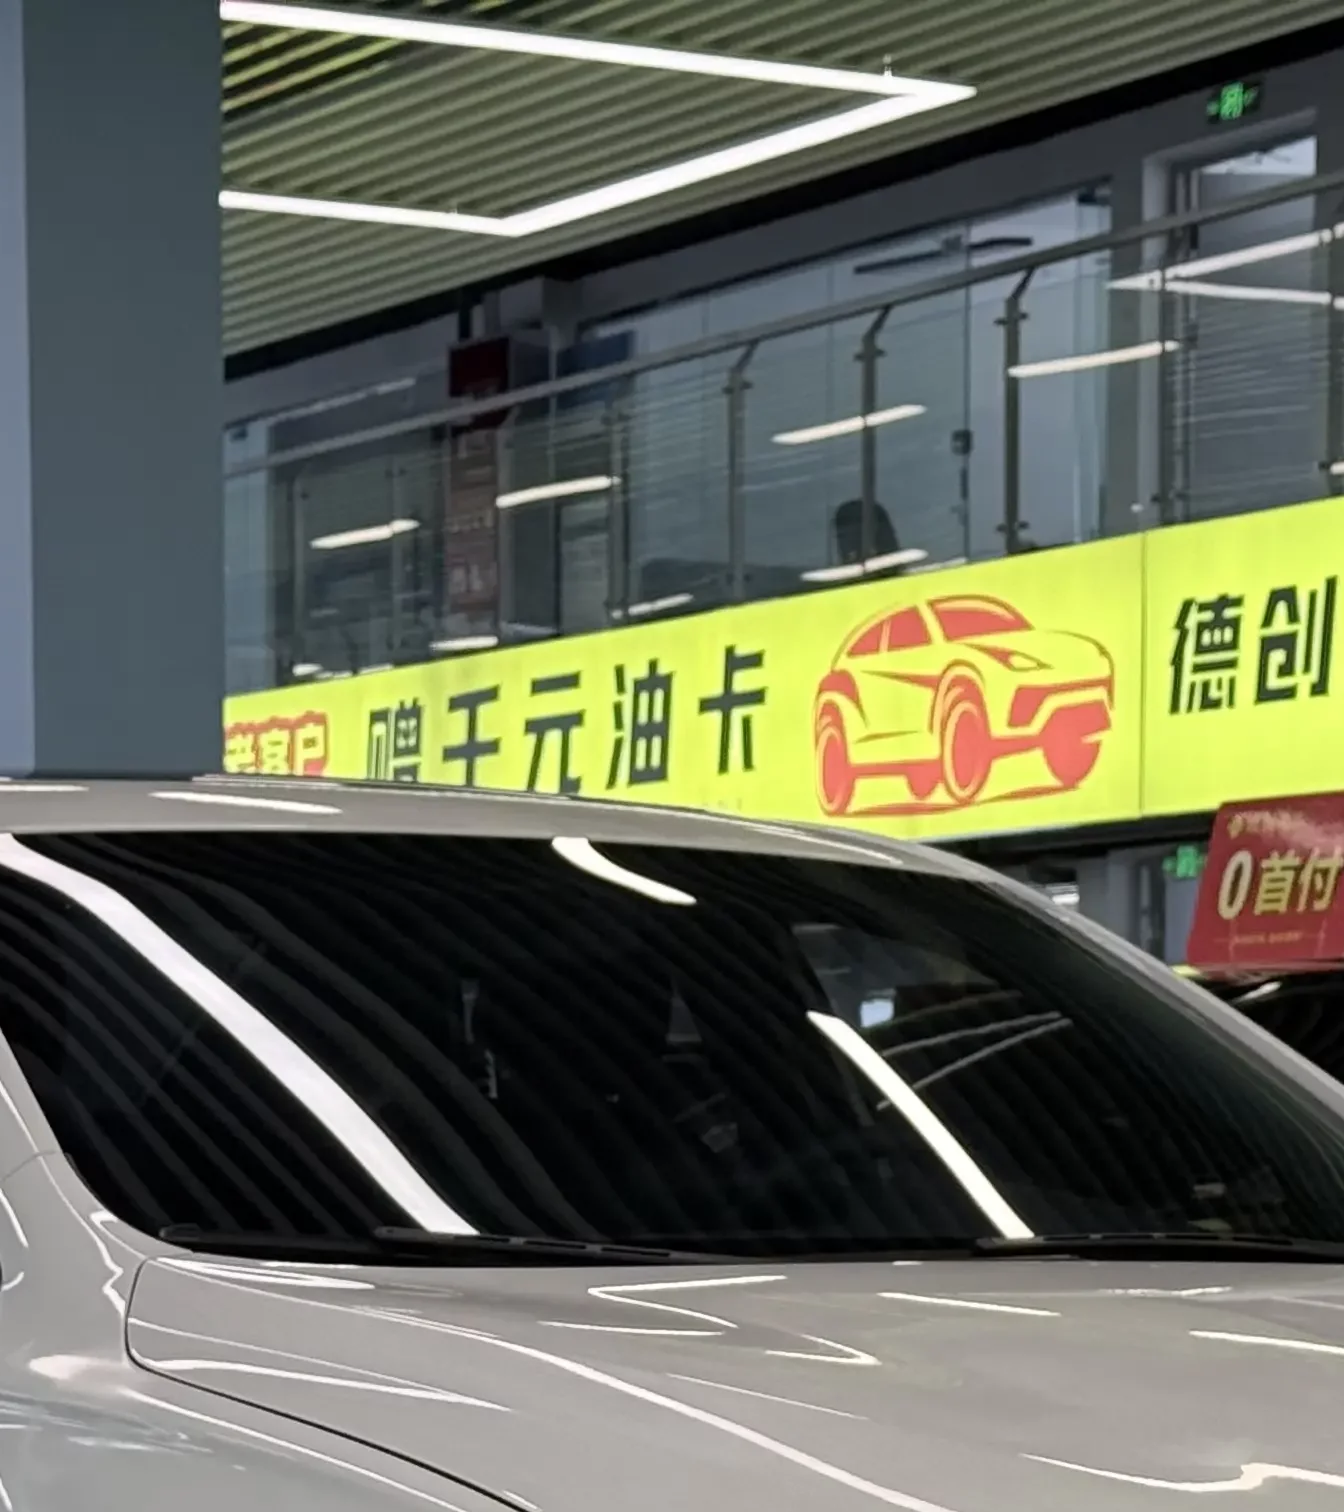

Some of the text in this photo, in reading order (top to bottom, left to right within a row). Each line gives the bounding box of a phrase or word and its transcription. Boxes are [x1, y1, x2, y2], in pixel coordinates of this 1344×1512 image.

[367, 645, 766, 793] 赠千元油卡
